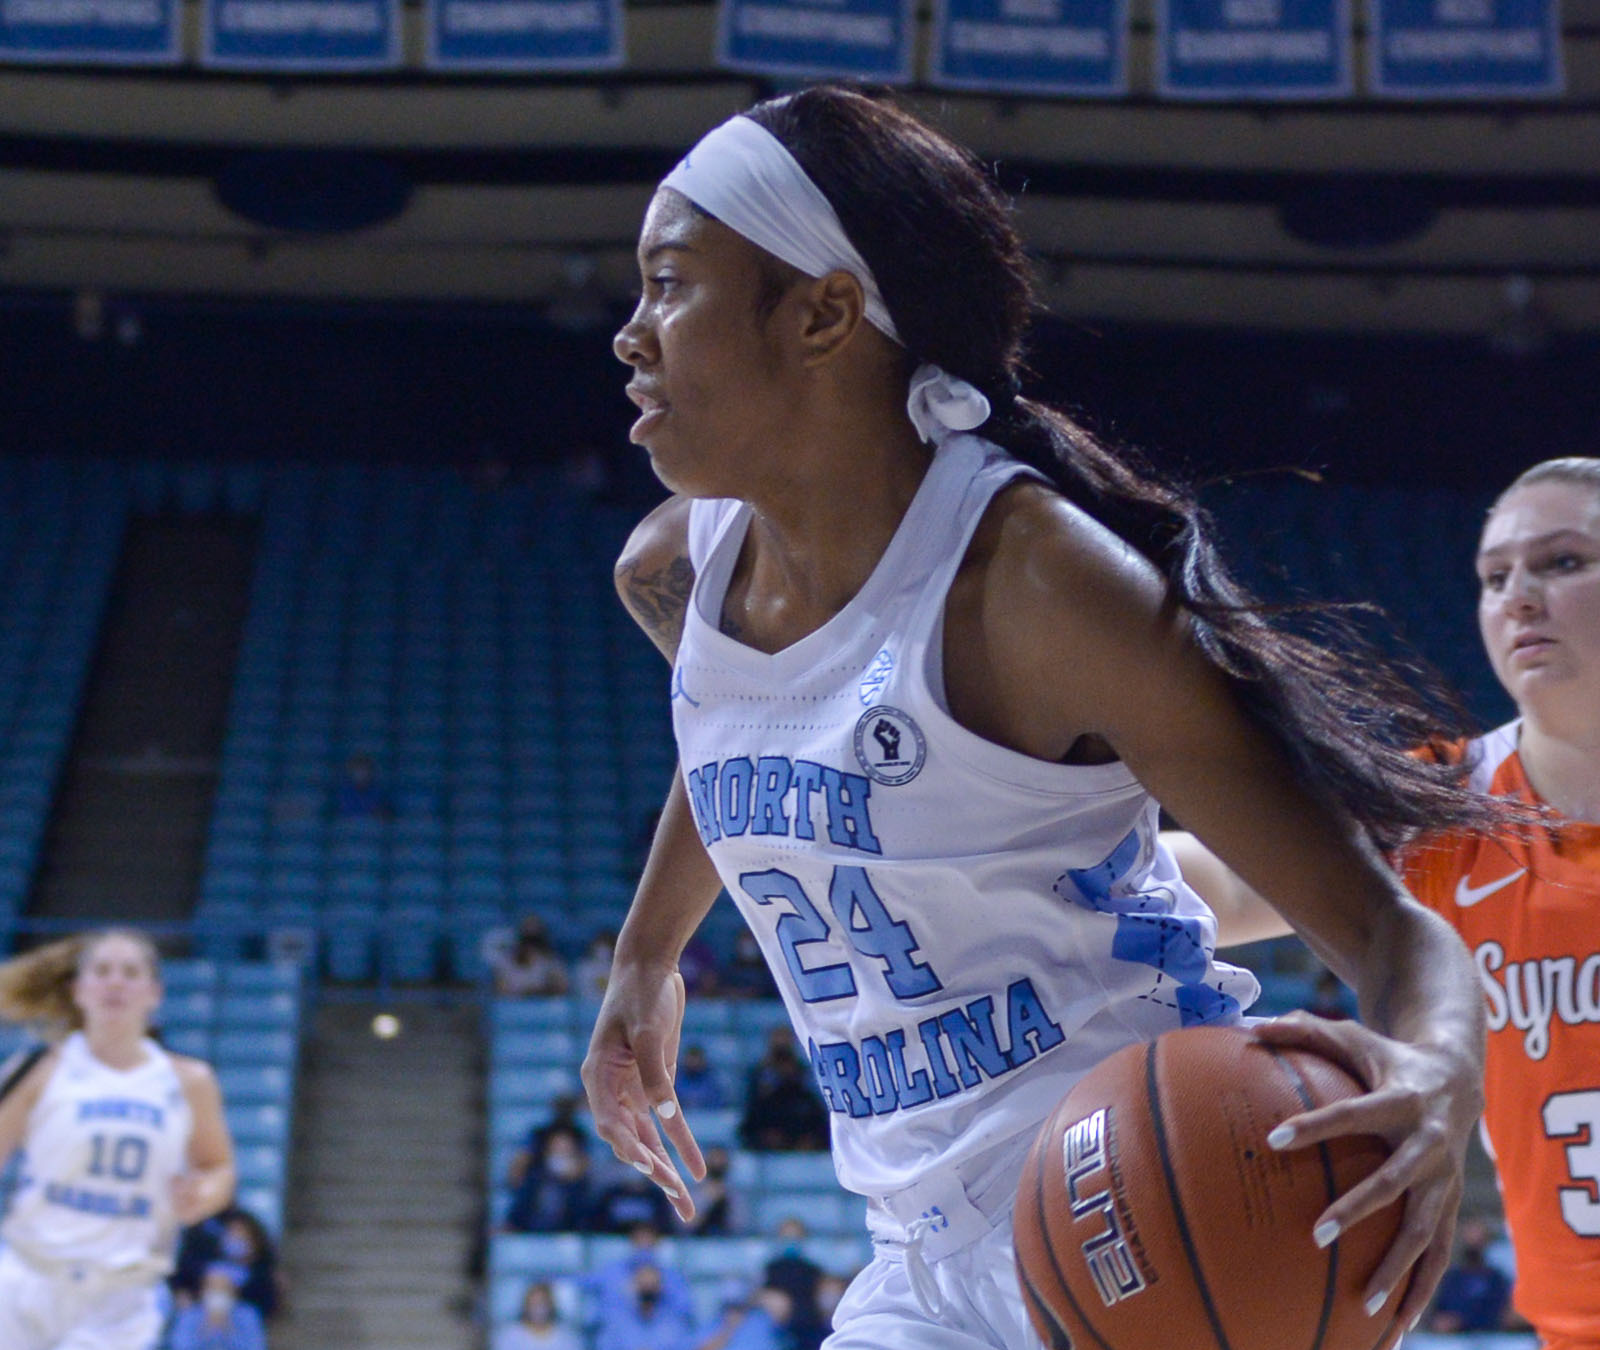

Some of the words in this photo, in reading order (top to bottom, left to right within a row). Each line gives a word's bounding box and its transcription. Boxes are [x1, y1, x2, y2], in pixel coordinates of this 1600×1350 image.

[688, 756, 883, 855] NORTH
[739, 864, 944, 1002] 24
[808, 977, 1065, 1119] AROLINA
[86, 1132, 150, 1182] 10
